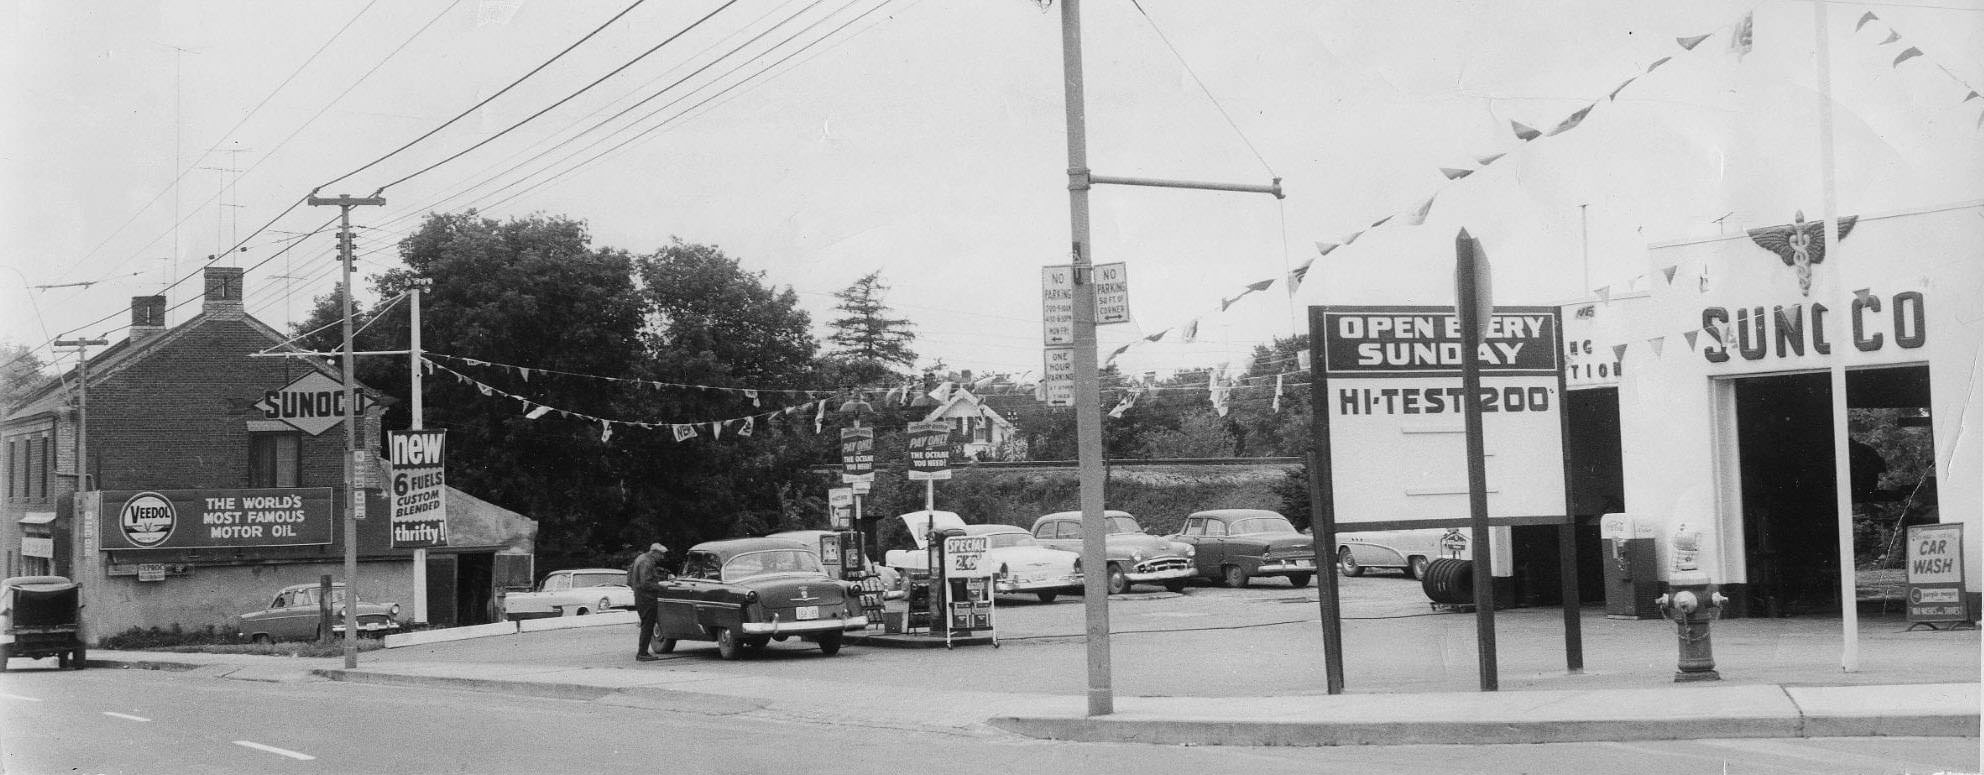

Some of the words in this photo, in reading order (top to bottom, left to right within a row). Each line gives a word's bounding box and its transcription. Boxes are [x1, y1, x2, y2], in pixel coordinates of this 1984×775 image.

[1052, 272, 1065, 285] NO
[1104, 268, 1118, 281] NO
[1045, 288, 1073, 300] PARKING
[1096, 281, 1127, 295] PARKING
[1338, 315, 1436, 340] OPEN
[1444, 316, 1544, 339] EERY
[1052, 351, 1069, 362] ONE
[1357, 342, 1524, 365] SUNDAY
[1050, 362, 1071, 372] HOUR
[264, 390, 365, 419] SUNOCO
[1339, 388, 1466, 416] HI-TEST
[393, 433, 443, 465] new
[909, 436, 927, 449] PAY
[927, 433, 949, 447] ONLY
[843, 455, 854, 463] THE
[910, 451, 924, 459] THE
[925, 451, 949, 459] OCTANE
[394, 473, 408, 496] 6
[411, 471, 442, 491] FUELS
[205, 496, 236, 511] THE
[242, 493, 302, 510] WORLD'S
[397, 489, 440, 507] CUSTOM
[131, 505, 170, 524] VEEDOL
[203, 511, 243, 525] MOST
[247, 509, 305, 524] FAMOUS
[396, 500, 441, 518] BLENDED
[211, 525, 263, 540] MOTOR
[271, 524, 298, 538] OIL
[395, 521, 446, 545] thrifty!
[948, 538, 986, 553] SPECIAL
[1920, 539, 1946, 555] CAR
[1914, 558, 1953, 575] WASH
